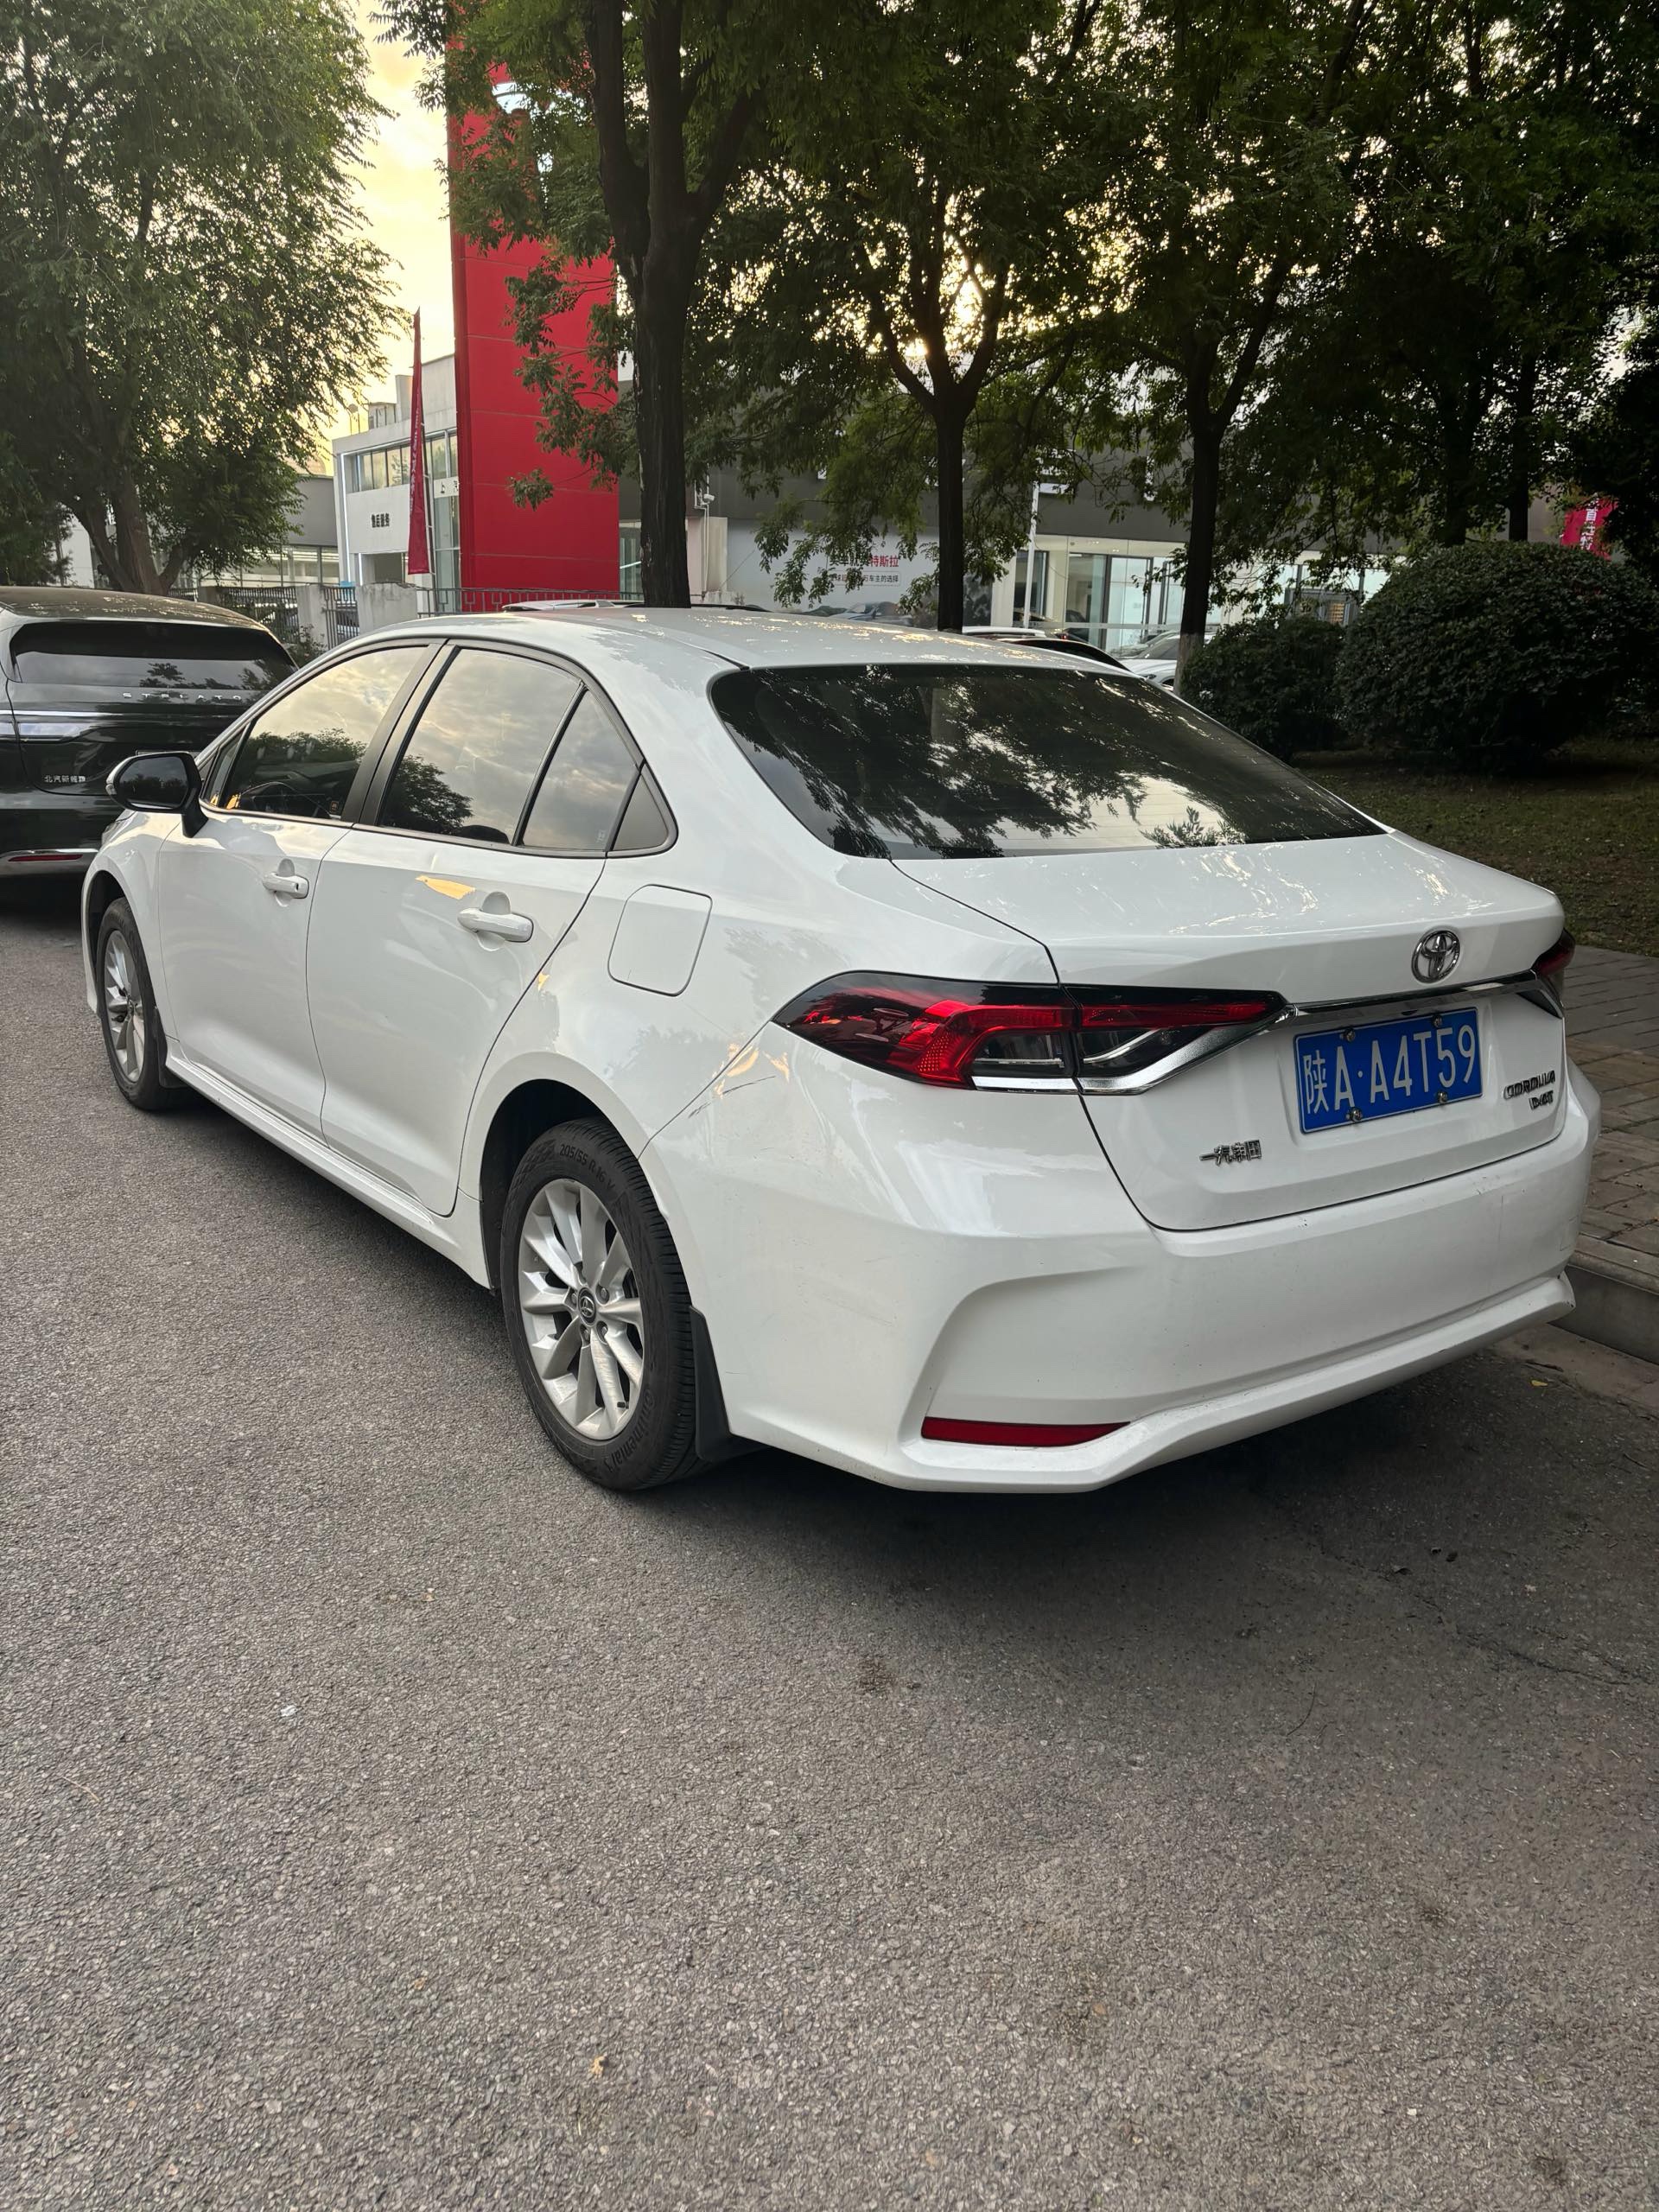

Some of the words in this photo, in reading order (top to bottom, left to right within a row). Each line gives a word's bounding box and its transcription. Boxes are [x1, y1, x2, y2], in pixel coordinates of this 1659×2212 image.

[1302, 1024, 1476, 1115] 陕A·A4T59
[1503, 1070, 1555, 1100] COROLLA
[559, 1143, 588, 1166] 205/55
[588, 1159, 596, 1173] R
[596, 1166, 607, 1183] 16
